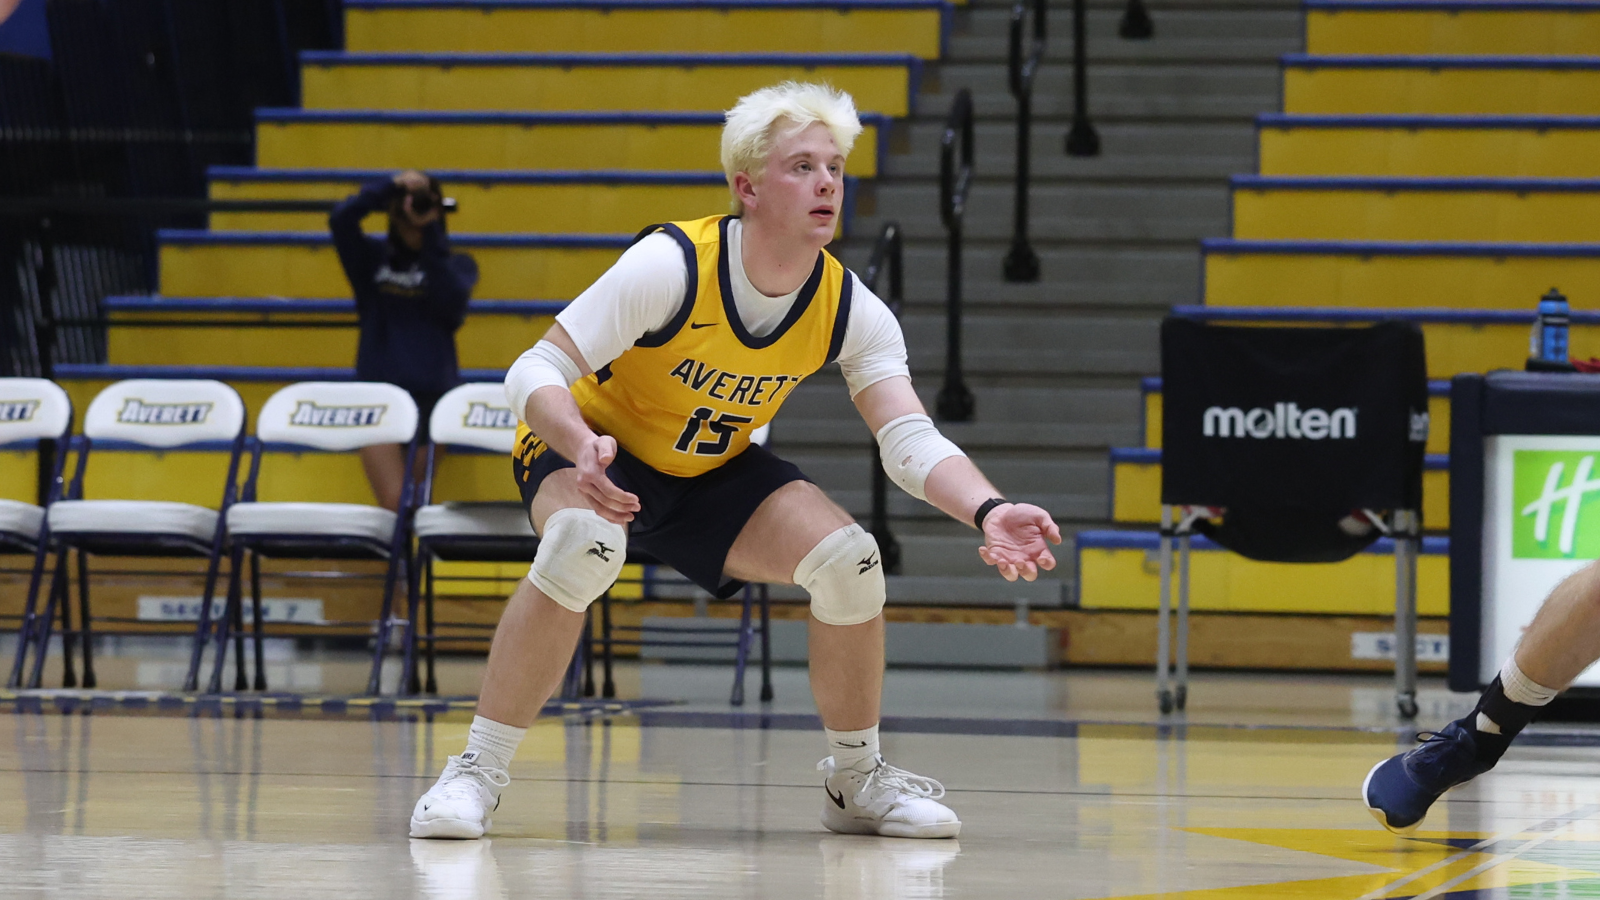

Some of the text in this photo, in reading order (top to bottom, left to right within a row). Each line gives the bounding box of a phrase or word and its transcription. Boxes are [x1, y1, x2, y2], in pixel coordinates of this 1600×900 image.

[117, 399, 213, 424] AVERETT
[289, 401, 387, 427] AVERETT
[1203, 402, 1356, 440] molten
[672, 406, 755, 457] 15
